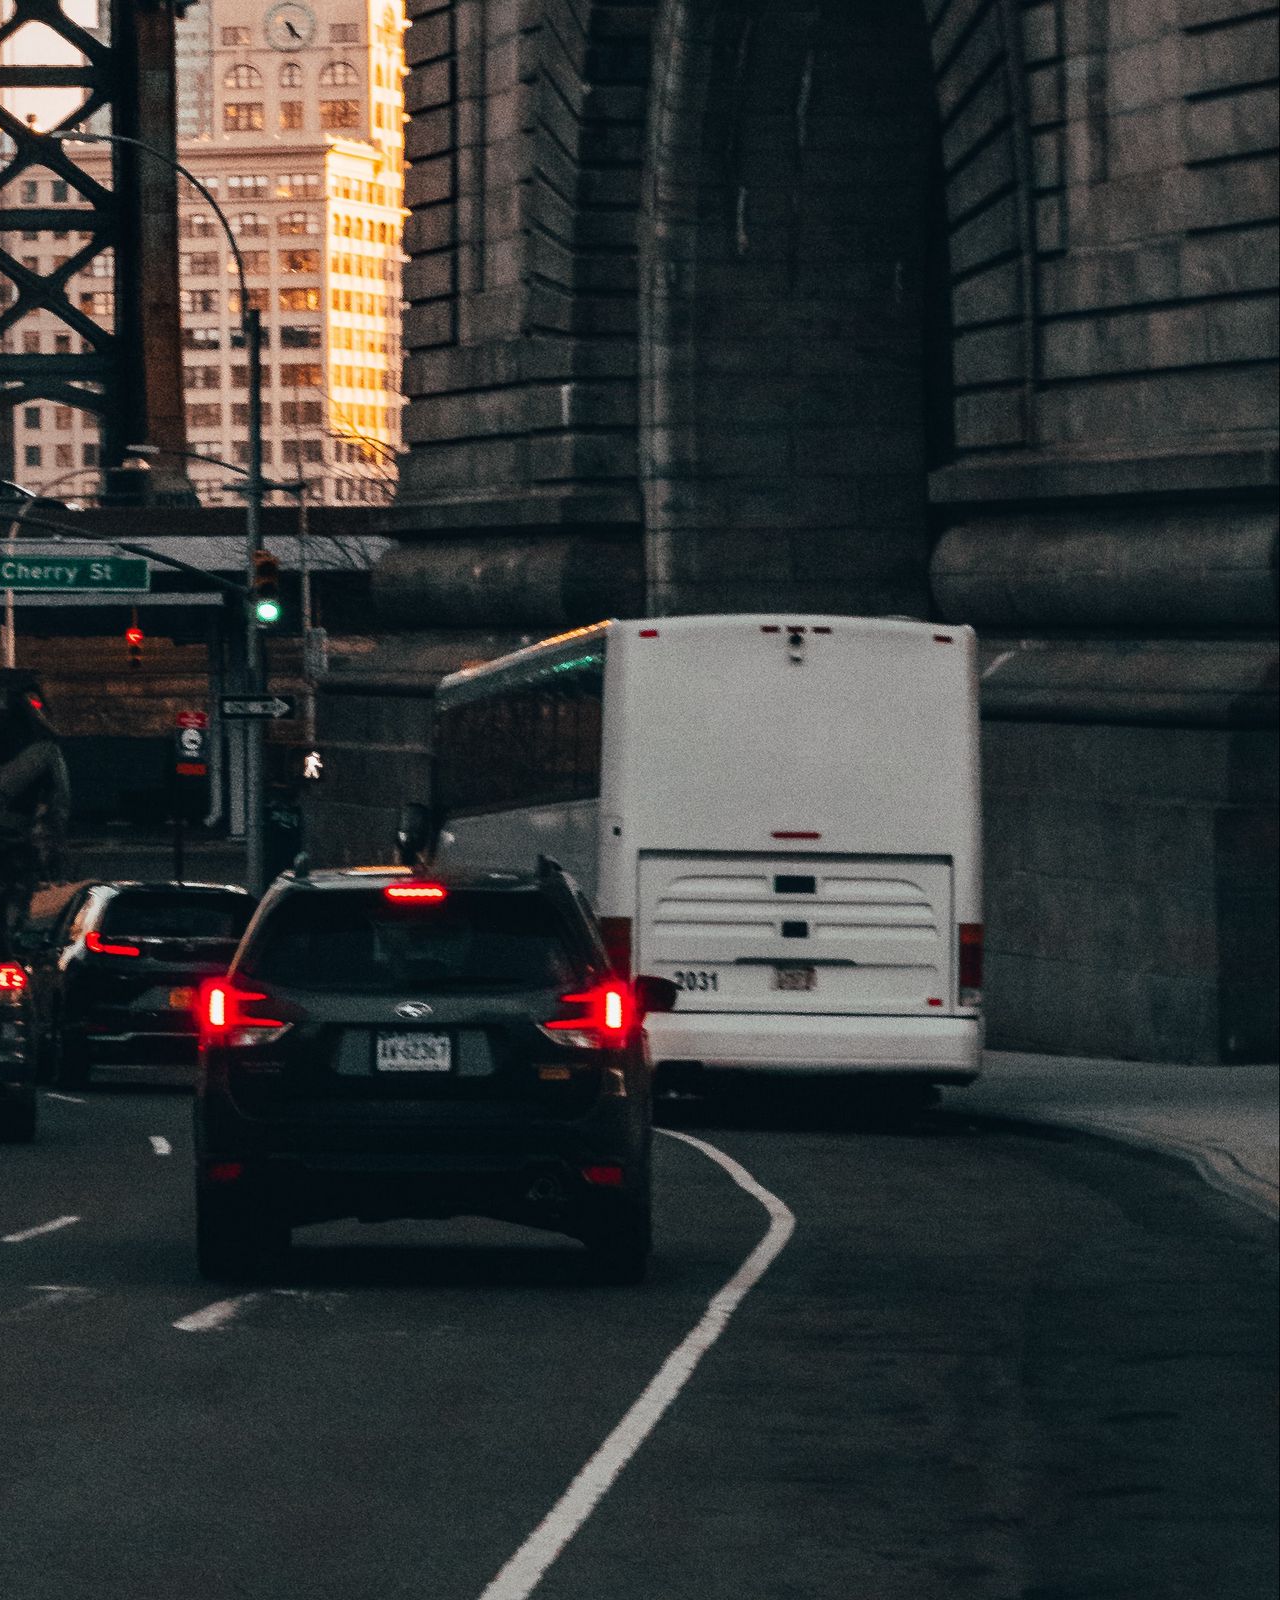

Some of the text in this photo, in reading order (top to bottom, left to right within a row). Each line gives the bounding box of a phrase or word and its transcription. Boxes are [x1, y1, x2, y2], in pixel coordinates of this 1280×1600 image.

[1, 561, 113, 583] Cherry St
[674, 970, 719, 992] 2031
